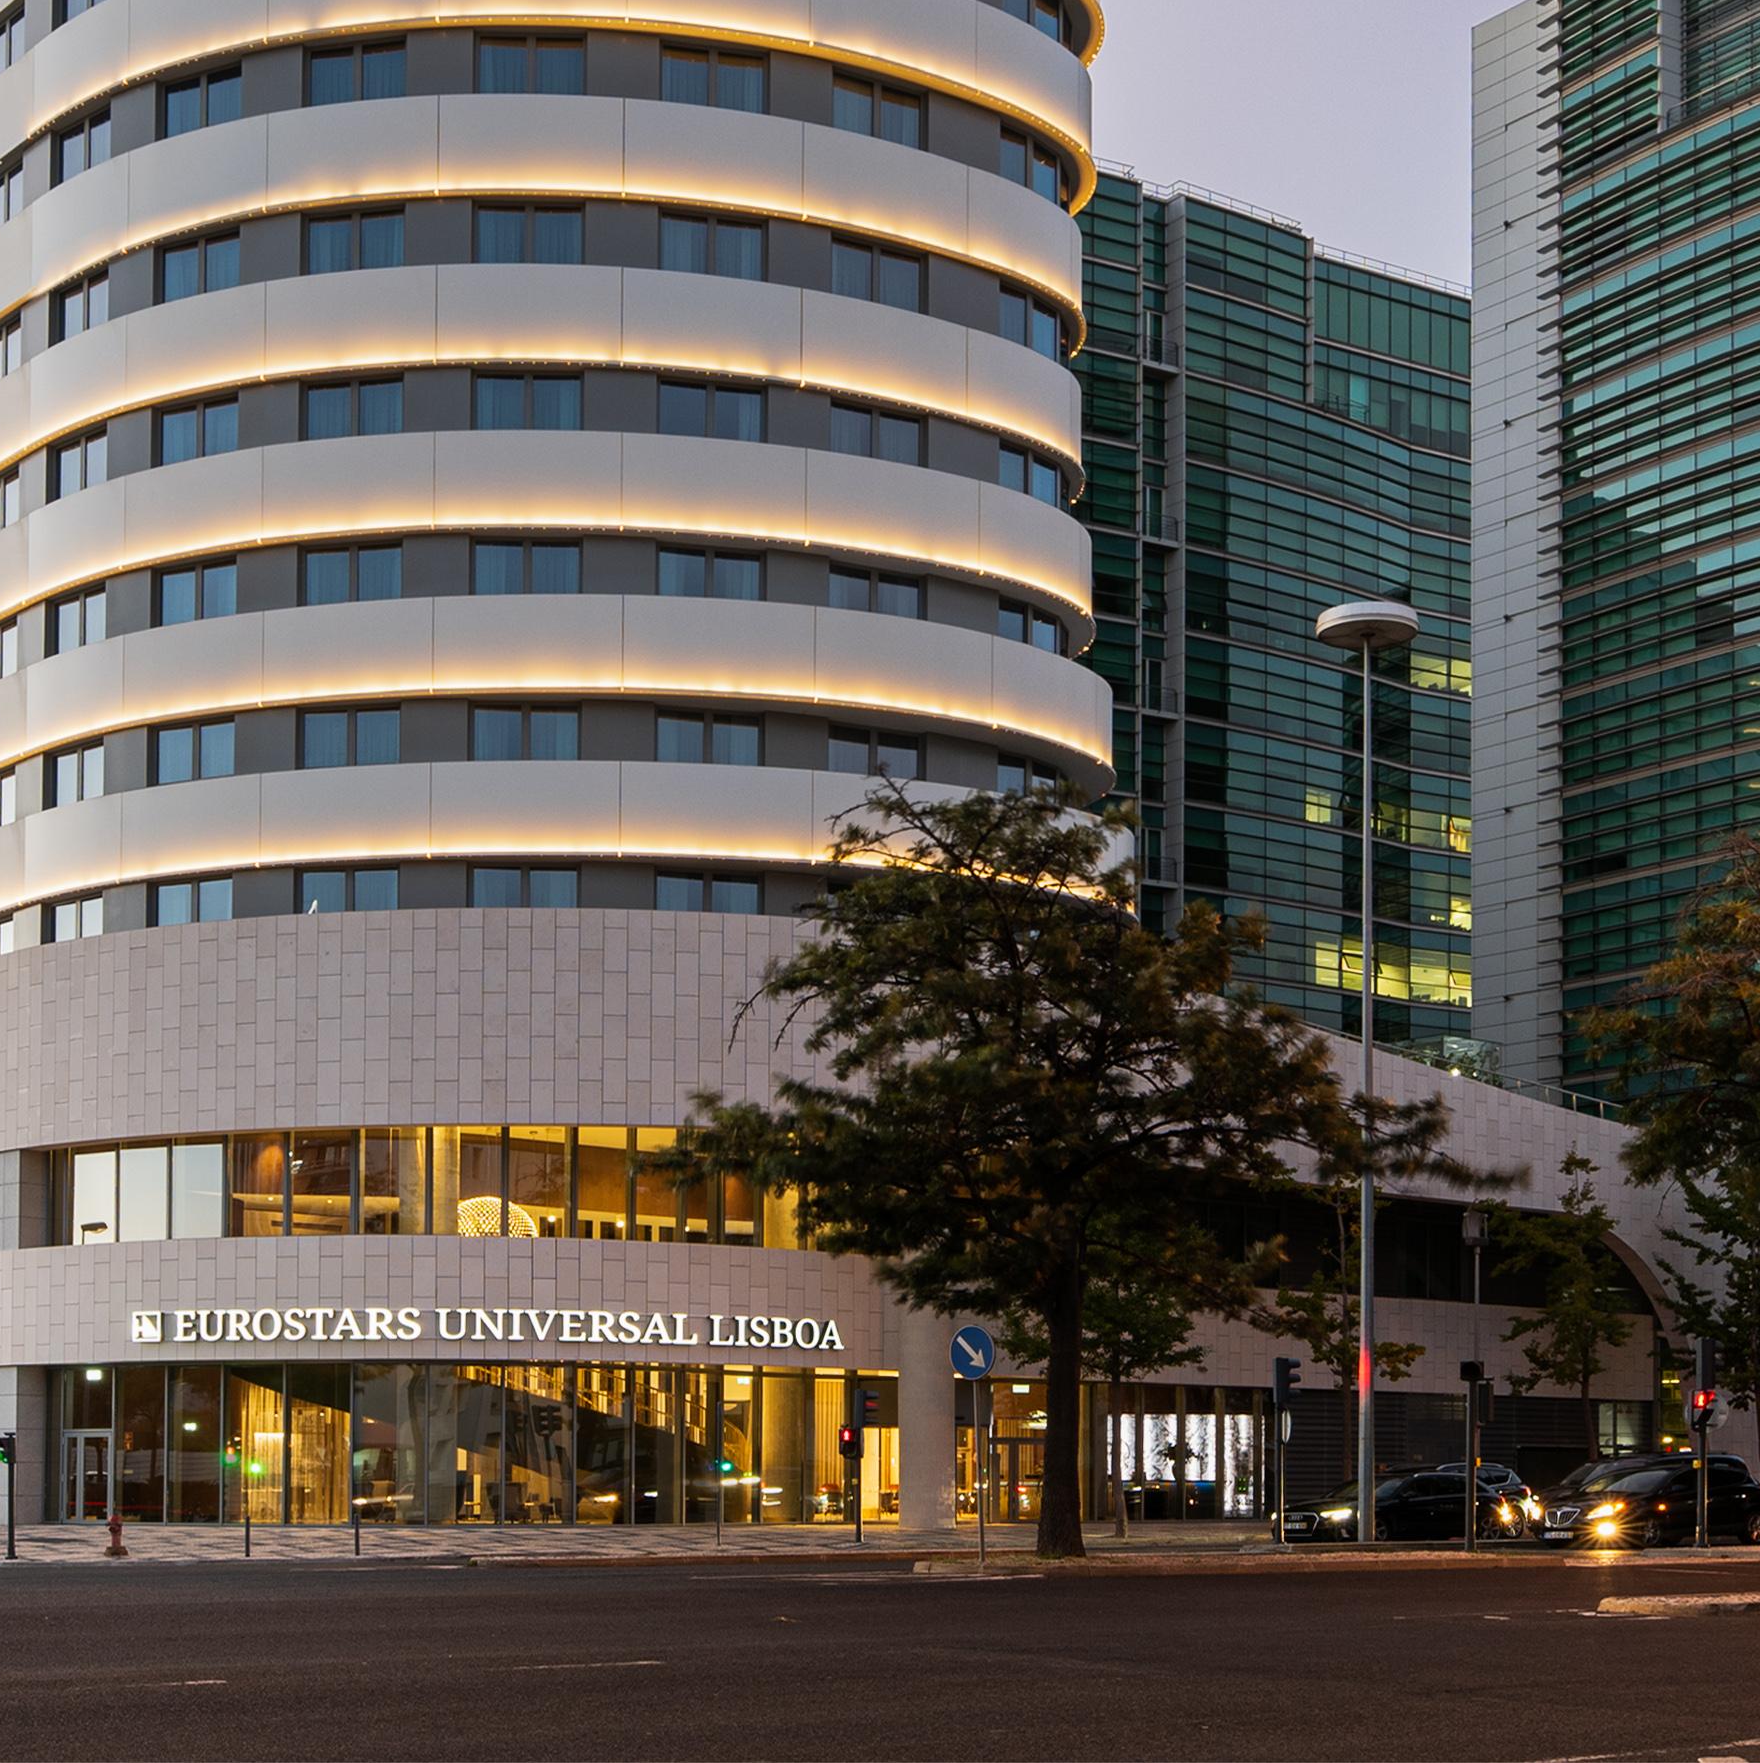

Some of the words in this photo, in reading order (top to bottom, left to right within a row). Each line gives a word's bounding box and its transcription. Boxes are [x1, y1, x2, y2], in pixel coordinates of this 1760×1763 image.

[173, 1307, 422, 1342] EUROSTARS
[435, 1308, 698, 1346] UNIVERSAL
[709, 1314, 845, 1350] LISBOA
